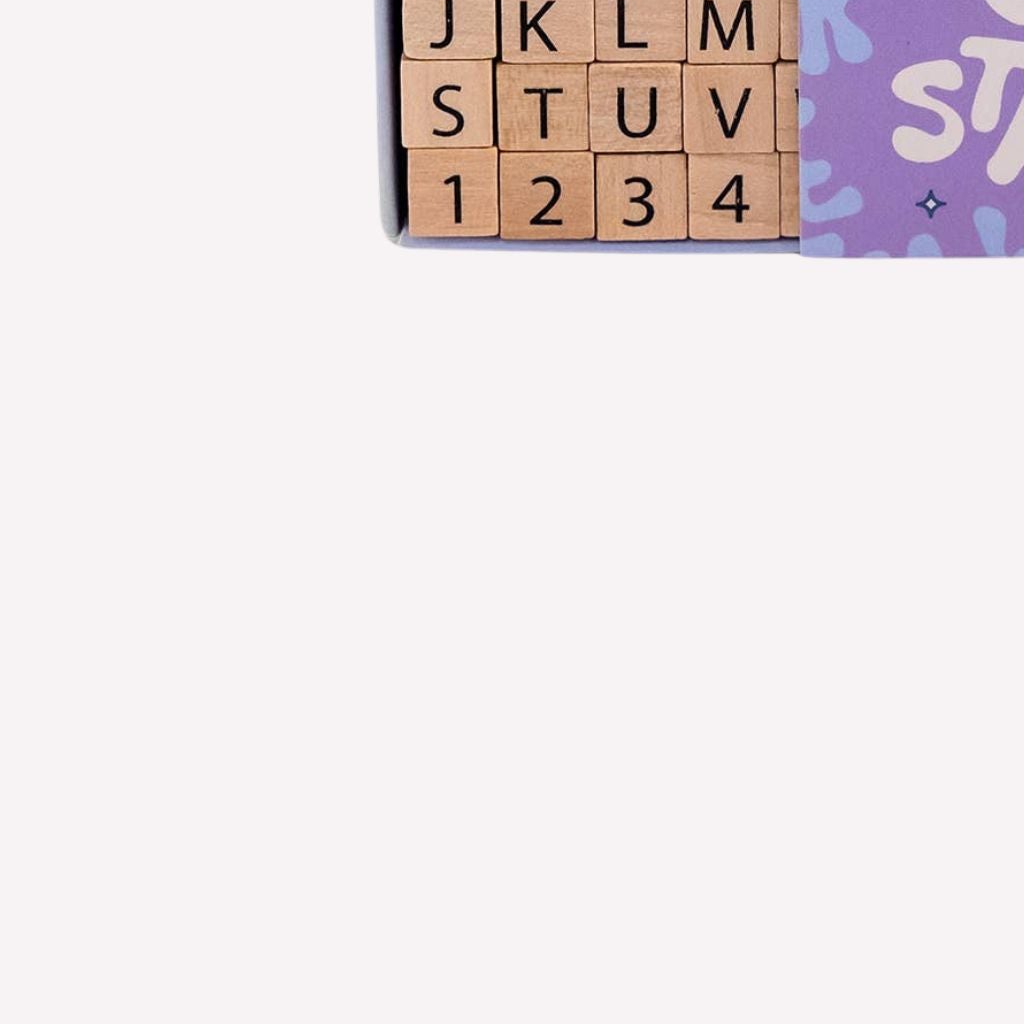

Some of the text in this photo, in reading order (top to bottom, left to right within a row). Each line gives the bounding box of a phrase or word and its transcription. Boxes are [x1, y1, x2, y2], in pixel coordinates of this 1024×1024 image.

[519, 0, 558, 52] K
[432, 84, 752, 139] S T U V
[443, 174, 462, 224] 1
[529, 175, 563, 226] 2
[622, 176, 655, 227] 3
[711, 174, 750, 223] 4
